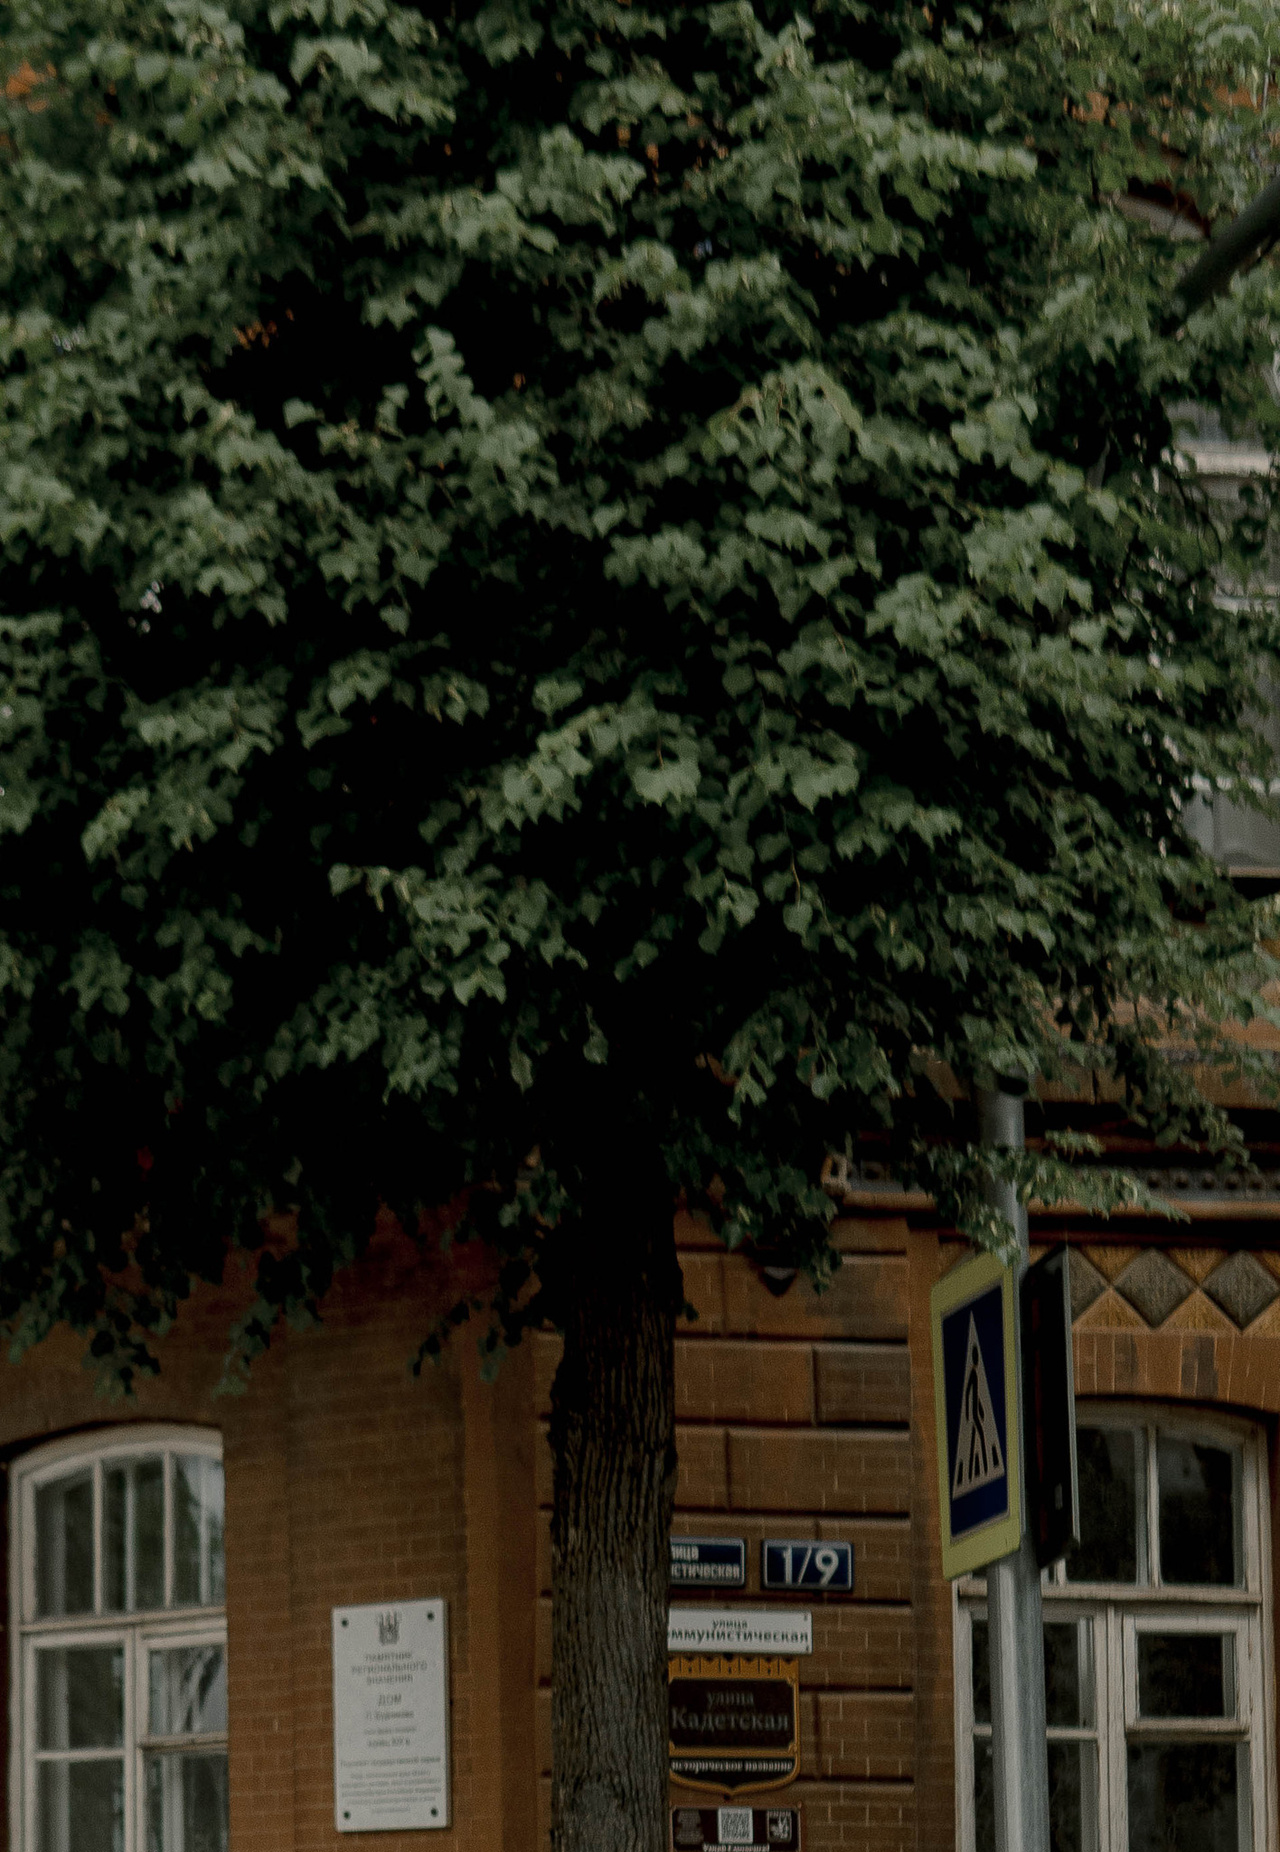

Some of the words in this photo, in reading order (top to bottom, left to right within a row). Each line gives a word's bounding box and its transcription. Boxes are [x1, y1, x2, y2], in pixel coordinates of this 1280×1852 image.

[782, 1545, 839, 1587] 1/9
[712, 1619, 748, 1630] улица
[668, 1629, 808, 1644] ммунистическая
[378, 1693, 402, 1707] ДОМ
[707, 1692, 754, 1709] улица
[671, 1706, 788, 1732] Кадетская
